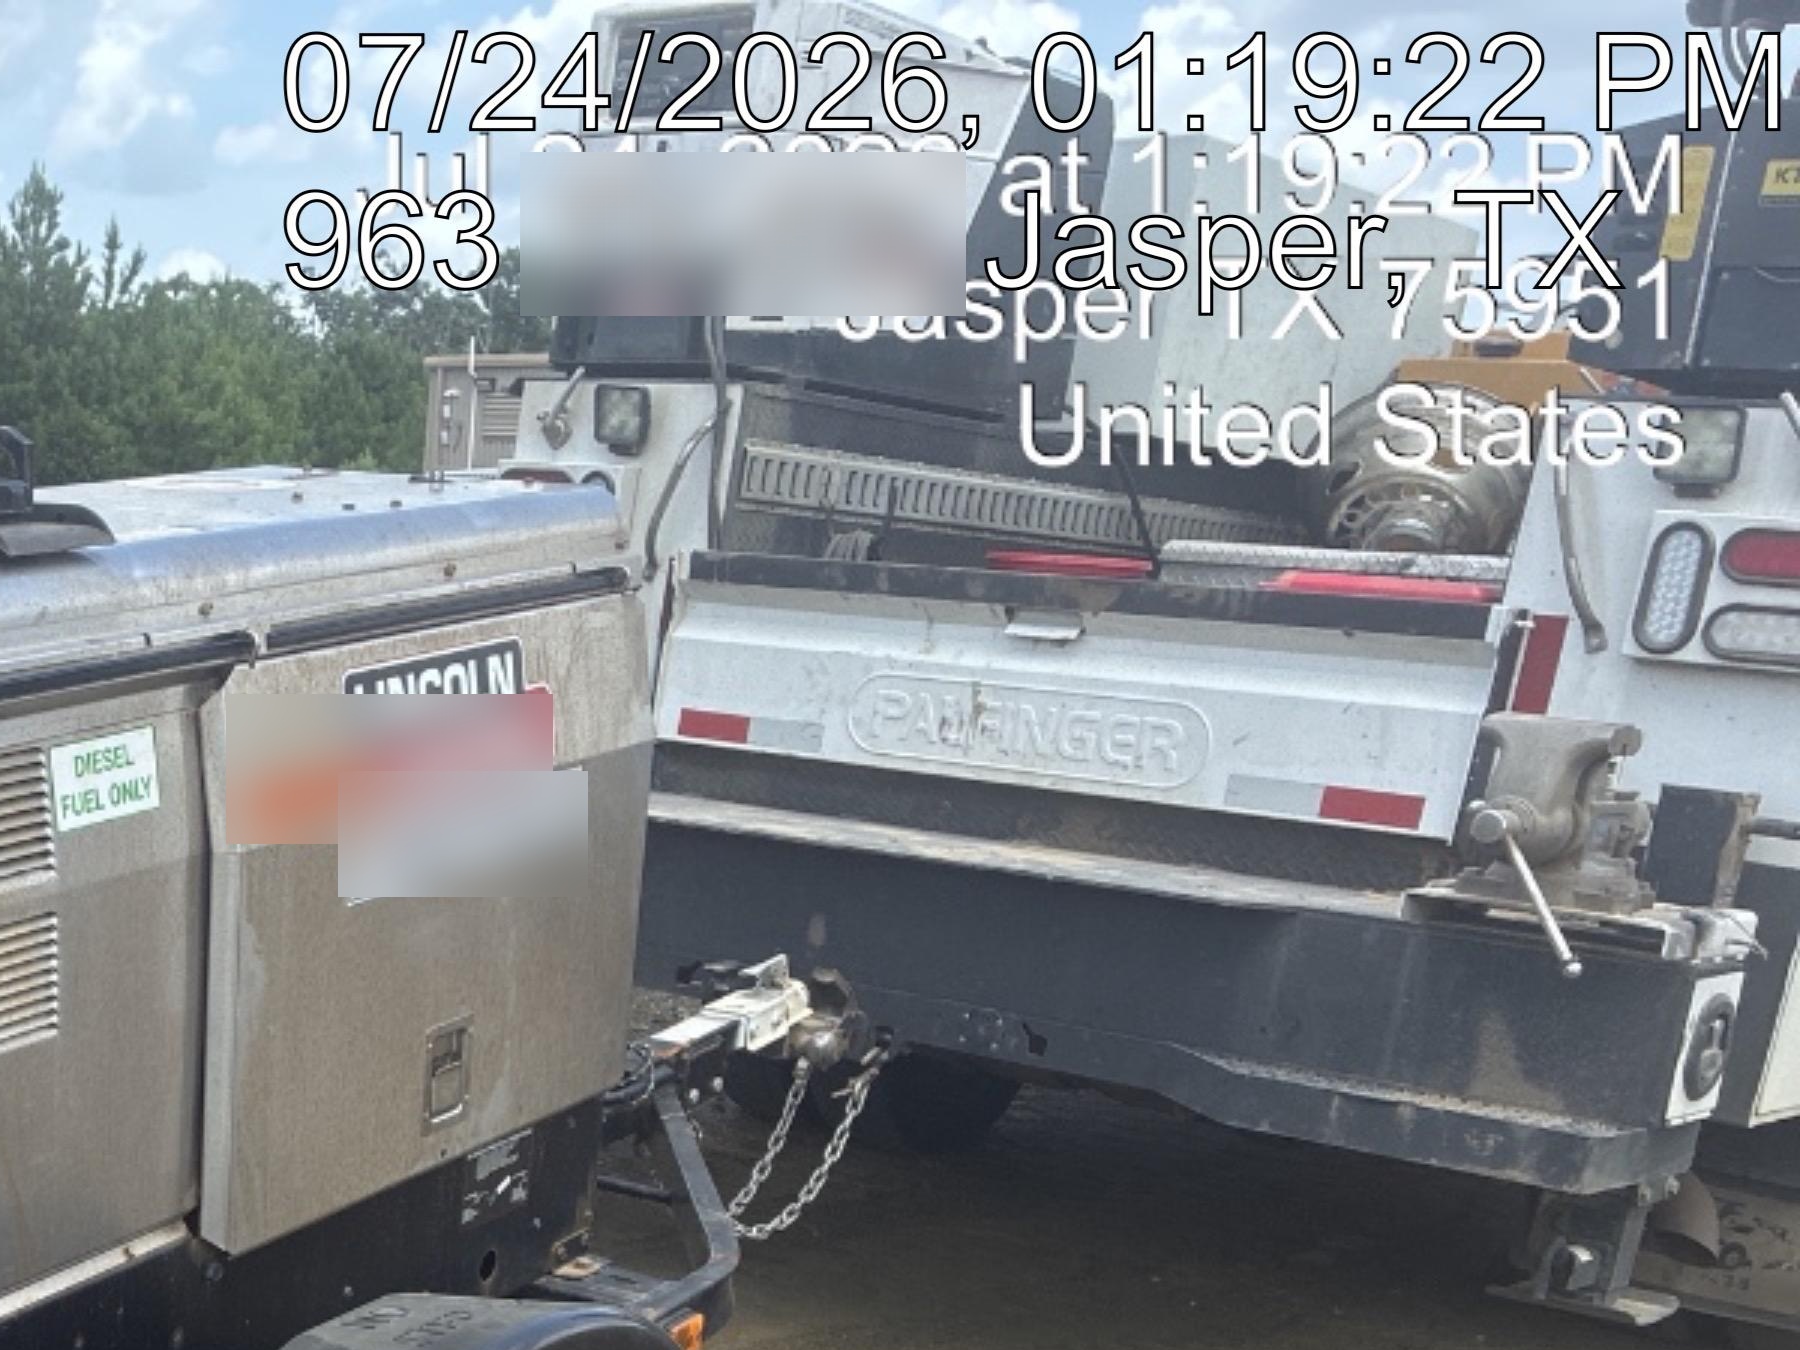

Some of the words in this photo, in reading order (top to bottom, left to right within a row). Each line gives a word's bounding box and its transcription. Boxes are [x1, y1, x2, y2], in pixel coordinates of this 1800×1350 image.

[870, 689, 1185, 772] PALFINGER
[73, 744, 136, 778] DIESEL
[61, 789, 106, 820] FUEL
[108, 775, 152, 808] ONLY
